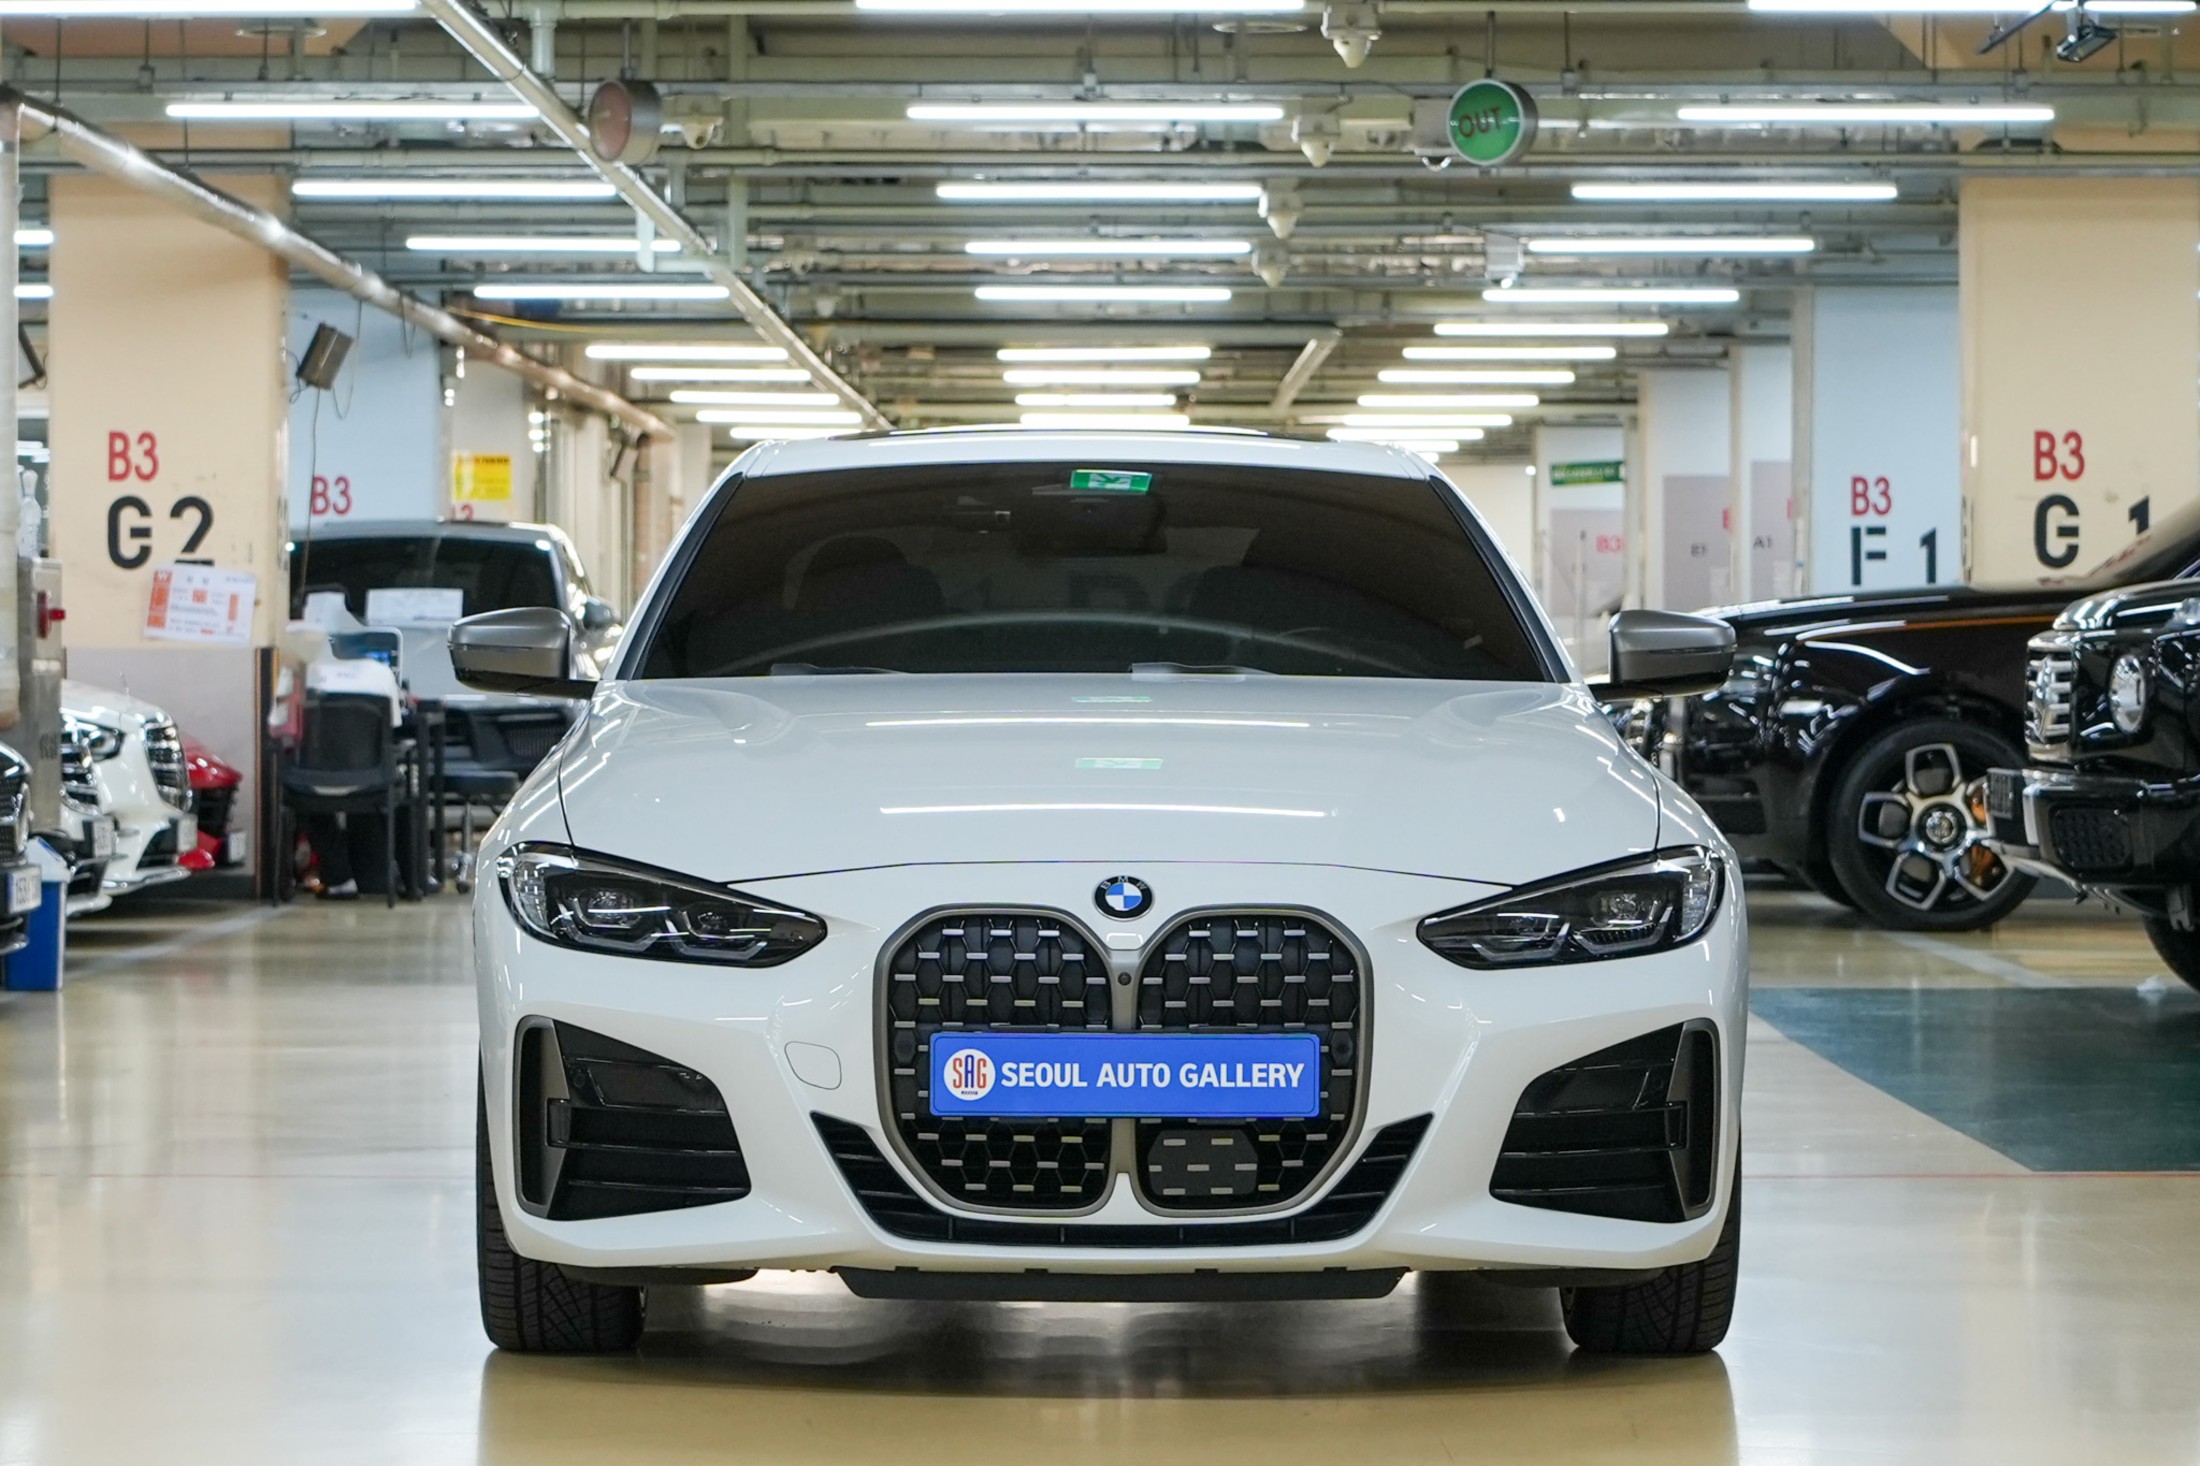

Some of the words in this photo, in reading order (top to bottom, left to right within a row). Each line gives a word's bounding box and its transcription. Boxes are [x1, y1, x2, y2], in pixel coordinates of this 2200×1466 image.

[1459, 106, 1502, 138] OUT
[108, 430, 159, 482] B3
[2034, 430, 2085, 481] B3
[312, 475, 352, 516] B3
[1851, 476, 1892, 516] B3
[2034, 494, 2080, 569] G
[1851, 526, 1887, 586] F
[1920, 527, 1936, 584] 1
[1101, 875, 1147, 890] BMW
[953, 1054, 987, 1089] SAG
[1001, 1061, 1088, 1088] SEOUL
[1096, 1062, 1171, 1088] AUTO
[1179, 1062, 1305, 1088] GALLERY
